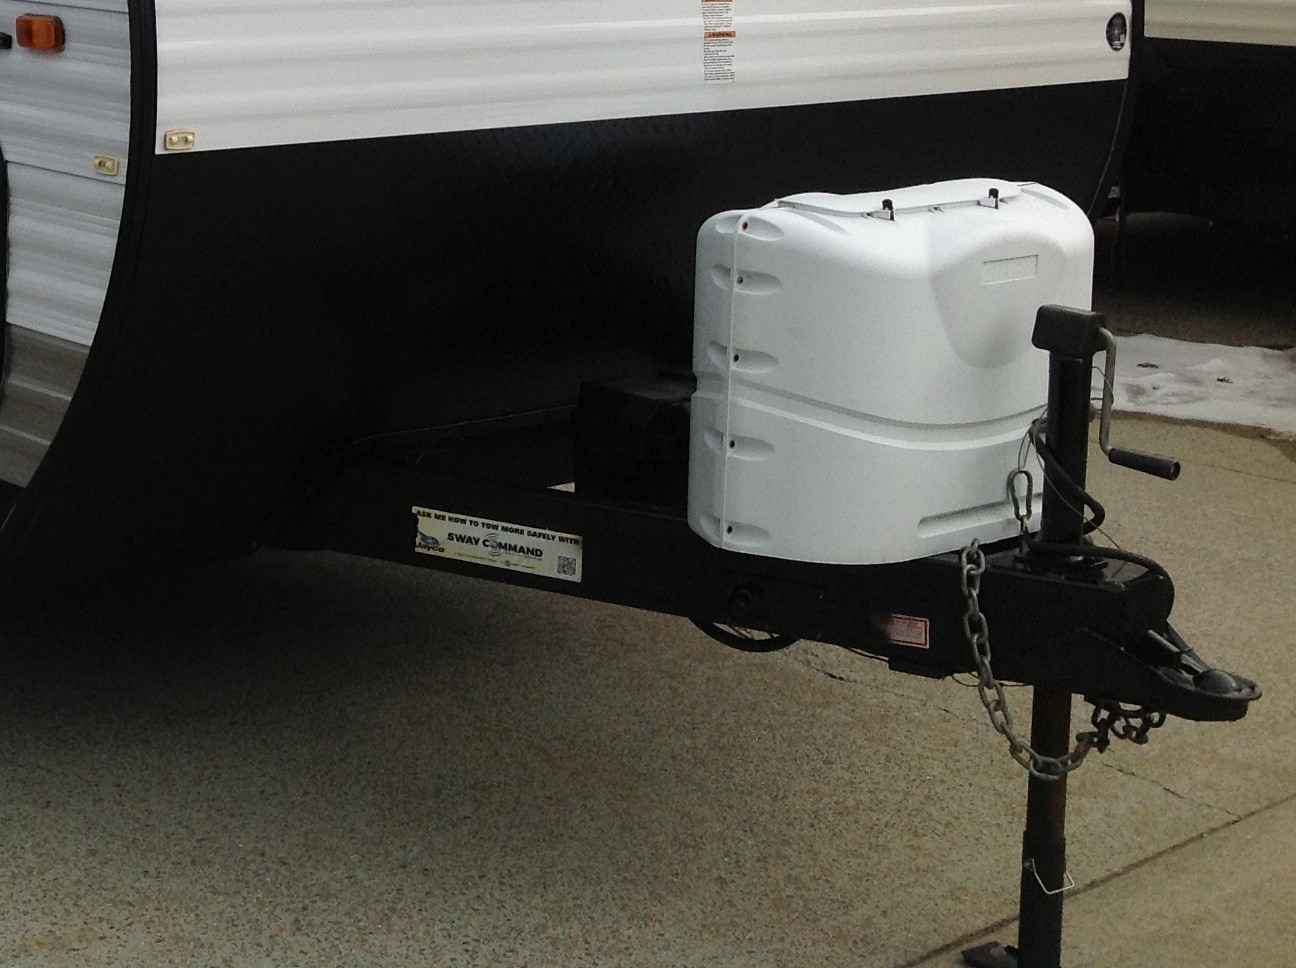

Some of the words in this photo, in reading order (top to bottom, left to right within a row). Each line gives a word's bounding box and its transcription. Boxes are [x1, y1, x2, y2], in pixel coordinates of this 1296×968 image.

[416, 510, 432, 519] ASK
[434, 513, 446, 522] ME
[448, 516, 467, 525] HOW
[469, 519, 479, 527] TO
[481, 522, 499, 531] TOW
[501, 525, 525, 535] MORE
[527, 530, 557, 541] SAFELY
[558, 536, 580, 545] WITH
[447, 532, 481, 546] SWAY
[482, 538, 543, 558] COMMAND
